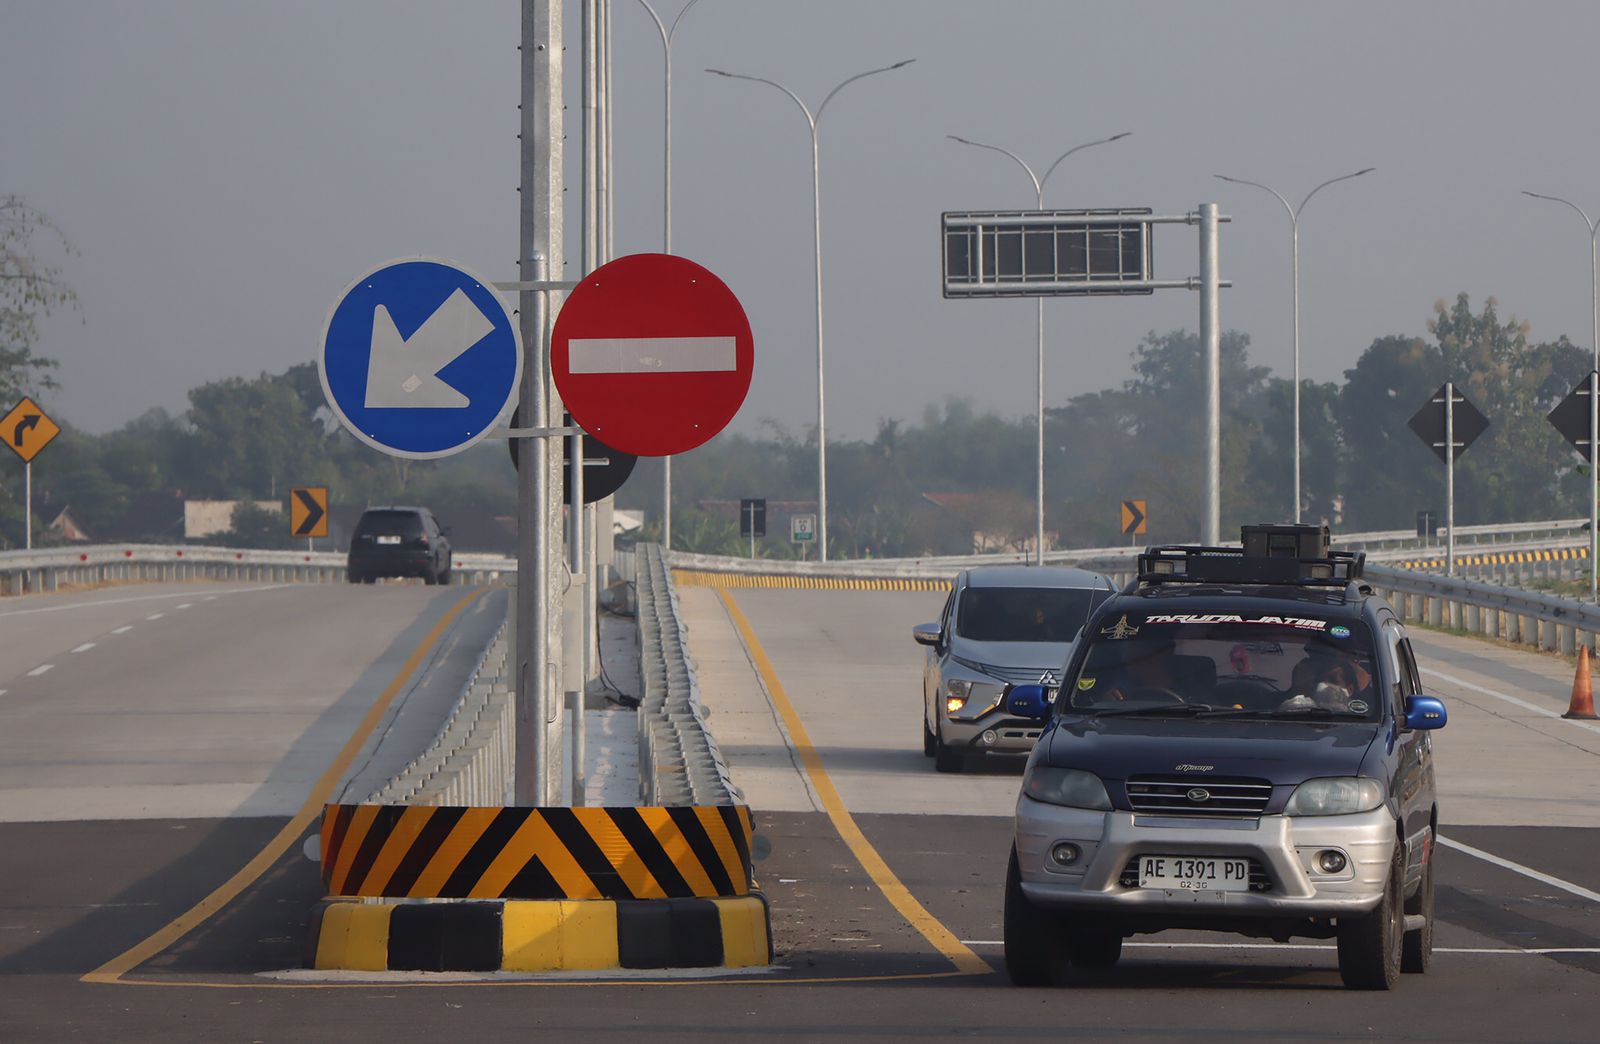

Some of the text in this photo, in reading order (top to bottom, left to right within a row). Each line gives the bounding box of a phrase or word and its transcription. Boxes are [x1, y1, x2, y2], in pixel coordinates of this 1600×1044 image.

[1145, 615, 1243, 624] TARUNA
[1246, 616, 1327, 628] JATIM
[1145, 859, 1245, 880] AE 1391 PD
